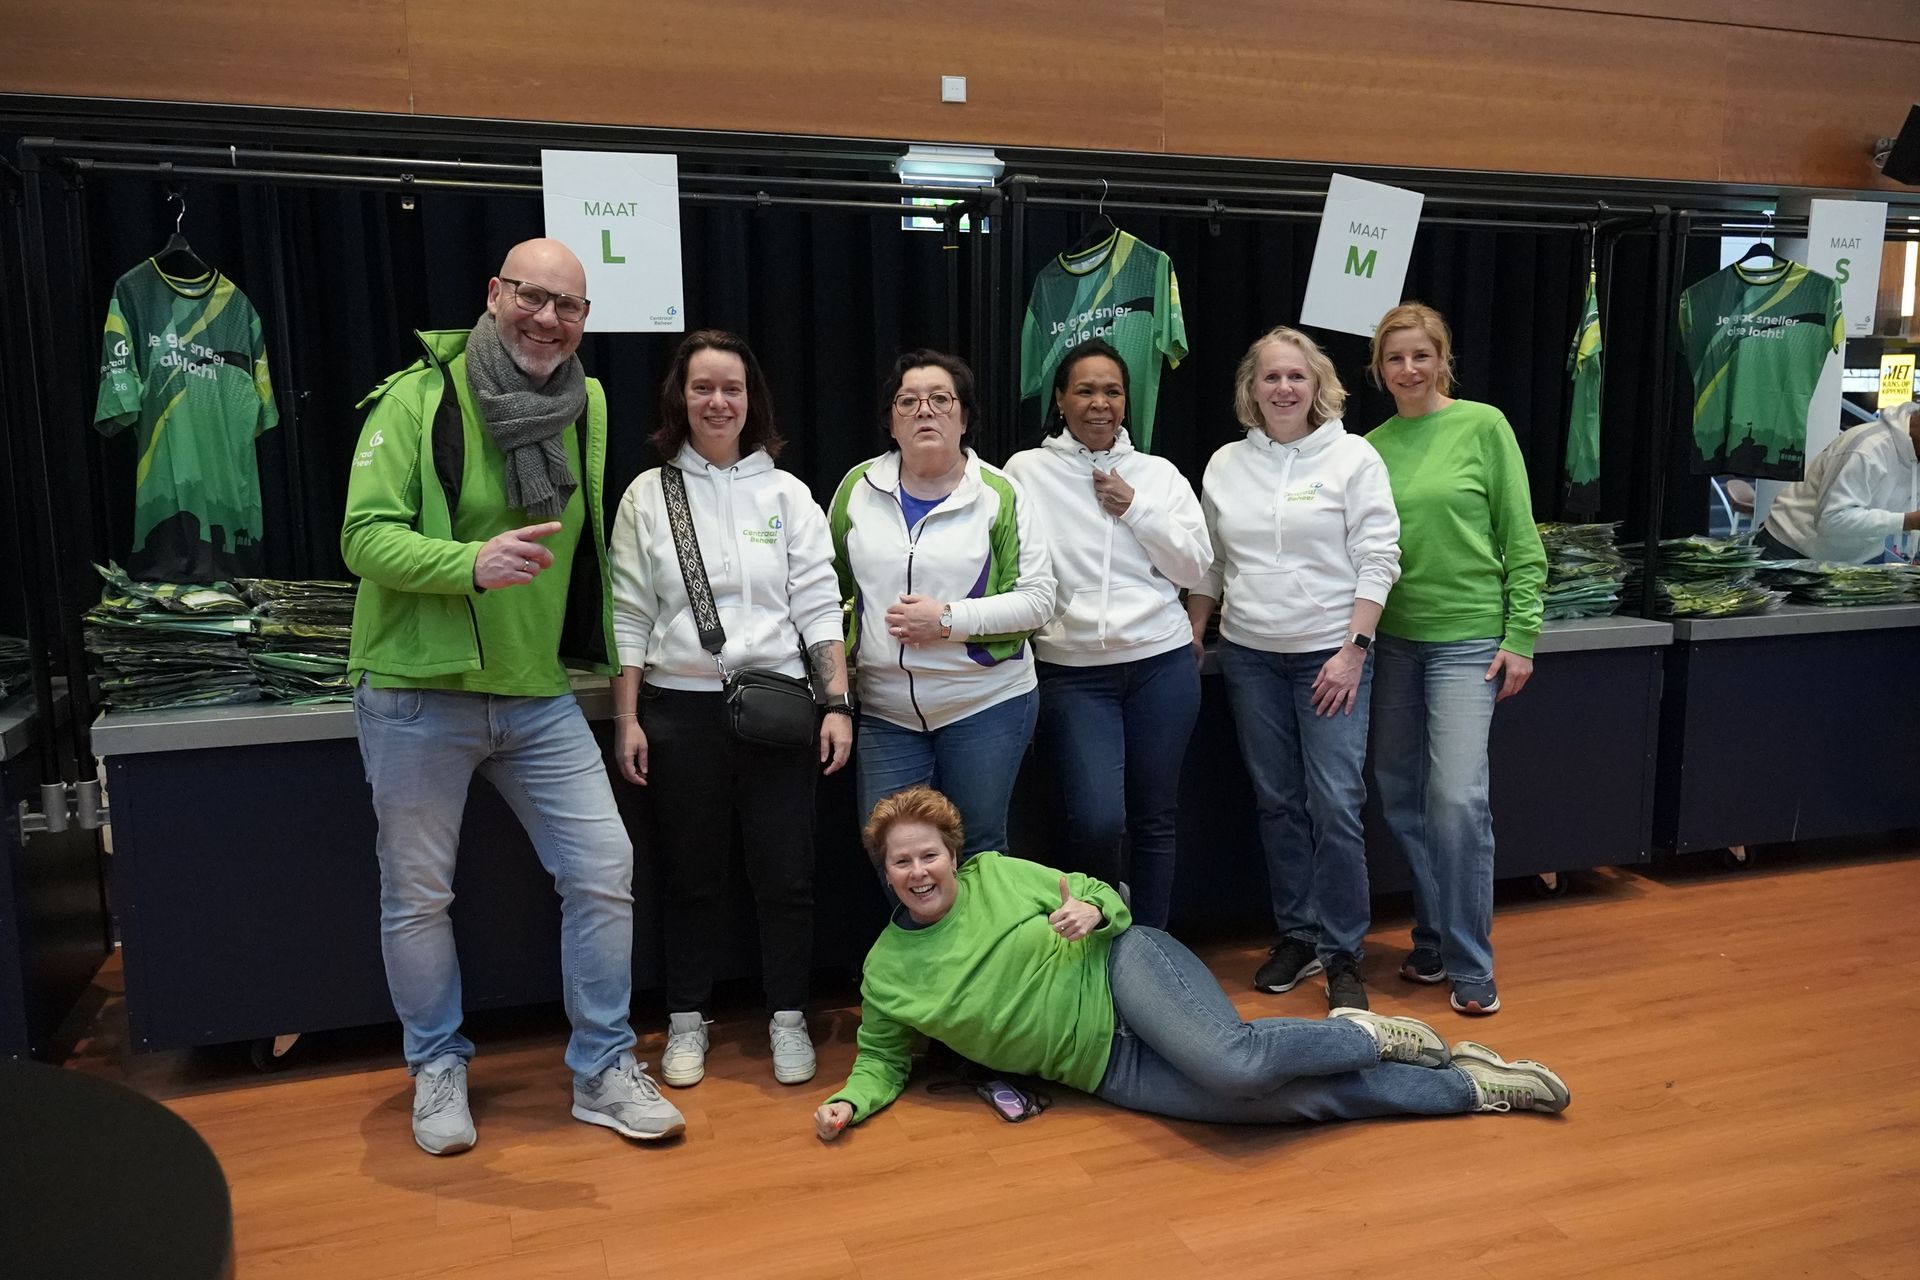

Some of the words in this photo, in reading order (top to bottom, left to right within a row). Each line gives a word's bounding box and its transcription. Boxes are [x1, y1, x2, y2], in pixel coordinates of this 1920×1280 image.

[584, 201, 638, 216] MAAT
[1350, 221, 1388, 241] MAAT
[601, 229, 626, 264] L
[1830, 237, 1862, 249] MAAT
[1344, 245, 1378, 279] M
[1835, 257, 1851, 284] S
[1050, 321, 1066, 335] Je
[1716, 315, 1730, 326] Je
[1756, 315, 1800, 327] sneller
[148, 332, 161, 348] Je
[1748, 326, 1786, 339] lacht!
[1884, 365, 1912, 380] MET
[743, 529, 778, 537] Centraal
